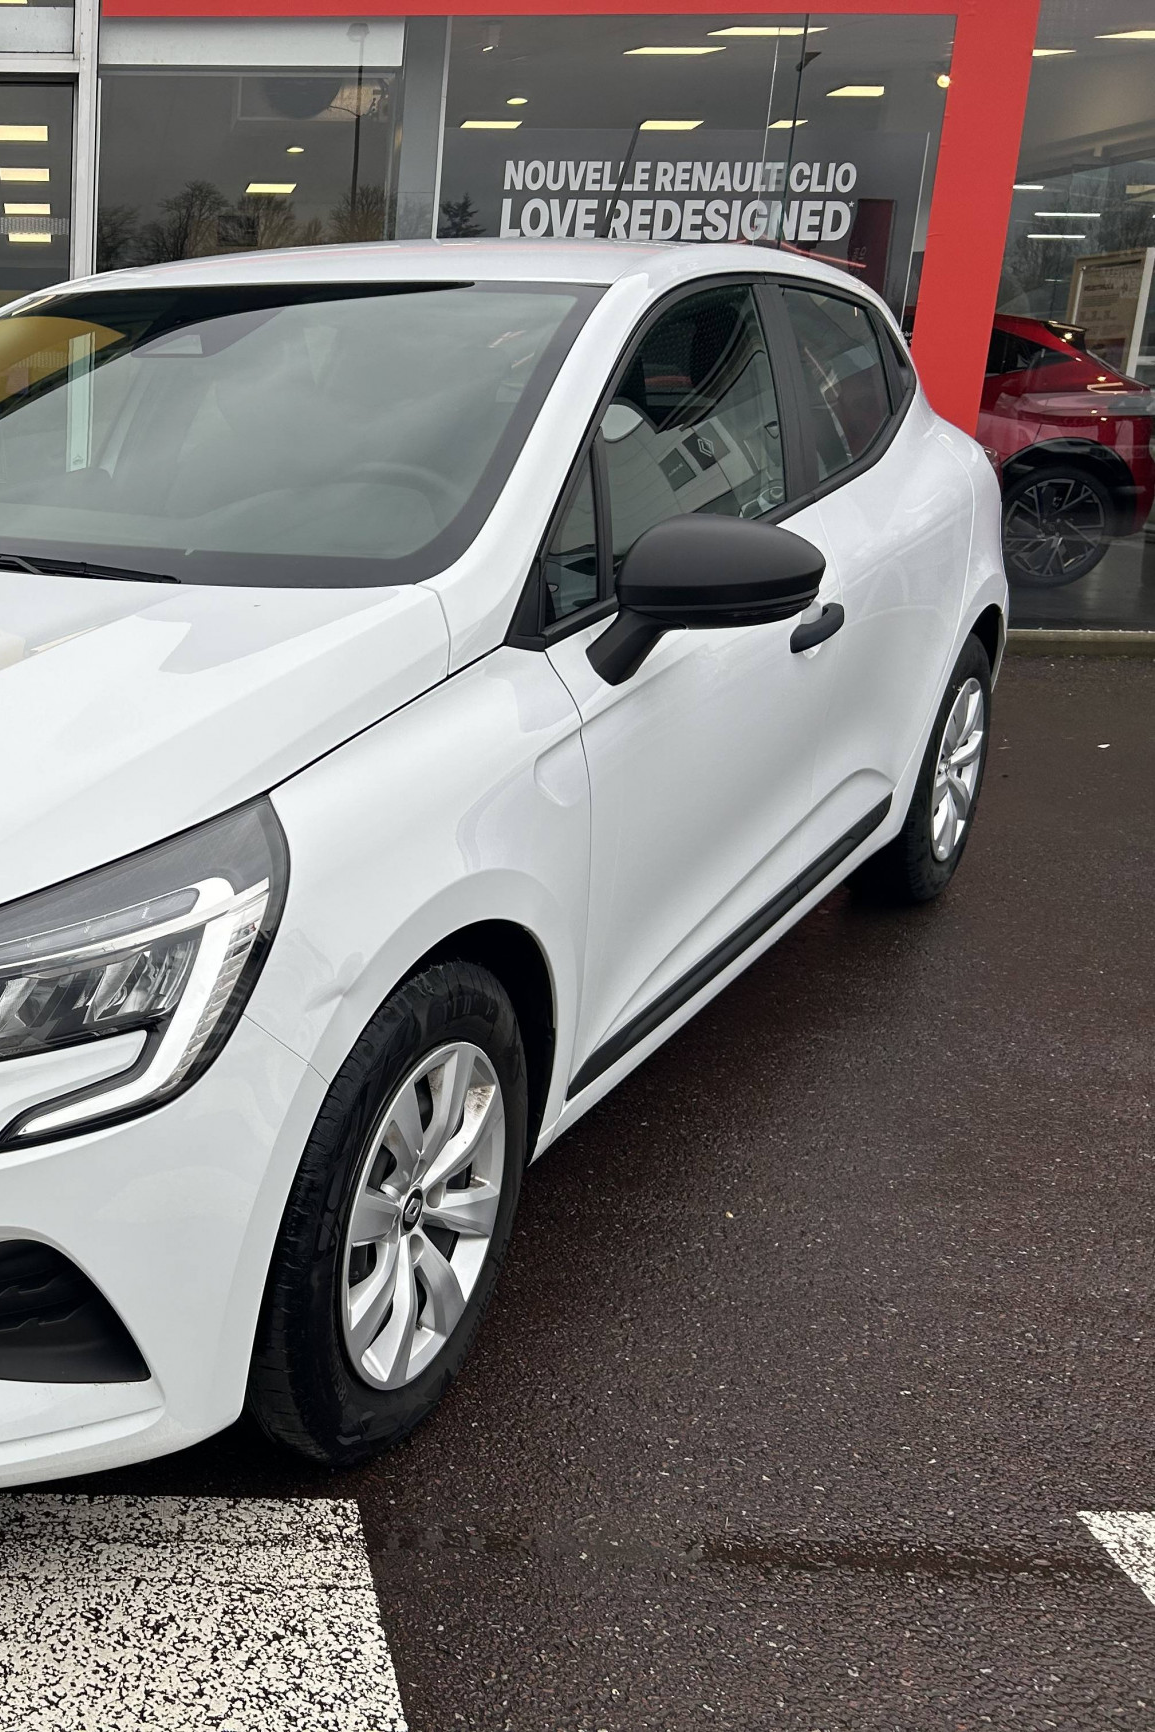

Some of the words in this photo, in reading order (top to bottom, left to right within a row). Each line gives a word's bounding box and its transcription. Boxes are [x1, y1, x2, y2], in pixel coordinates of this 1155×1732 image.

[503, 160, 651, 192] NOUVELLE
[654, 161, 784, 192] RENAULT
[789, 162, 858, 193] CLIO
[498, 198, 598, 239] LOVE
